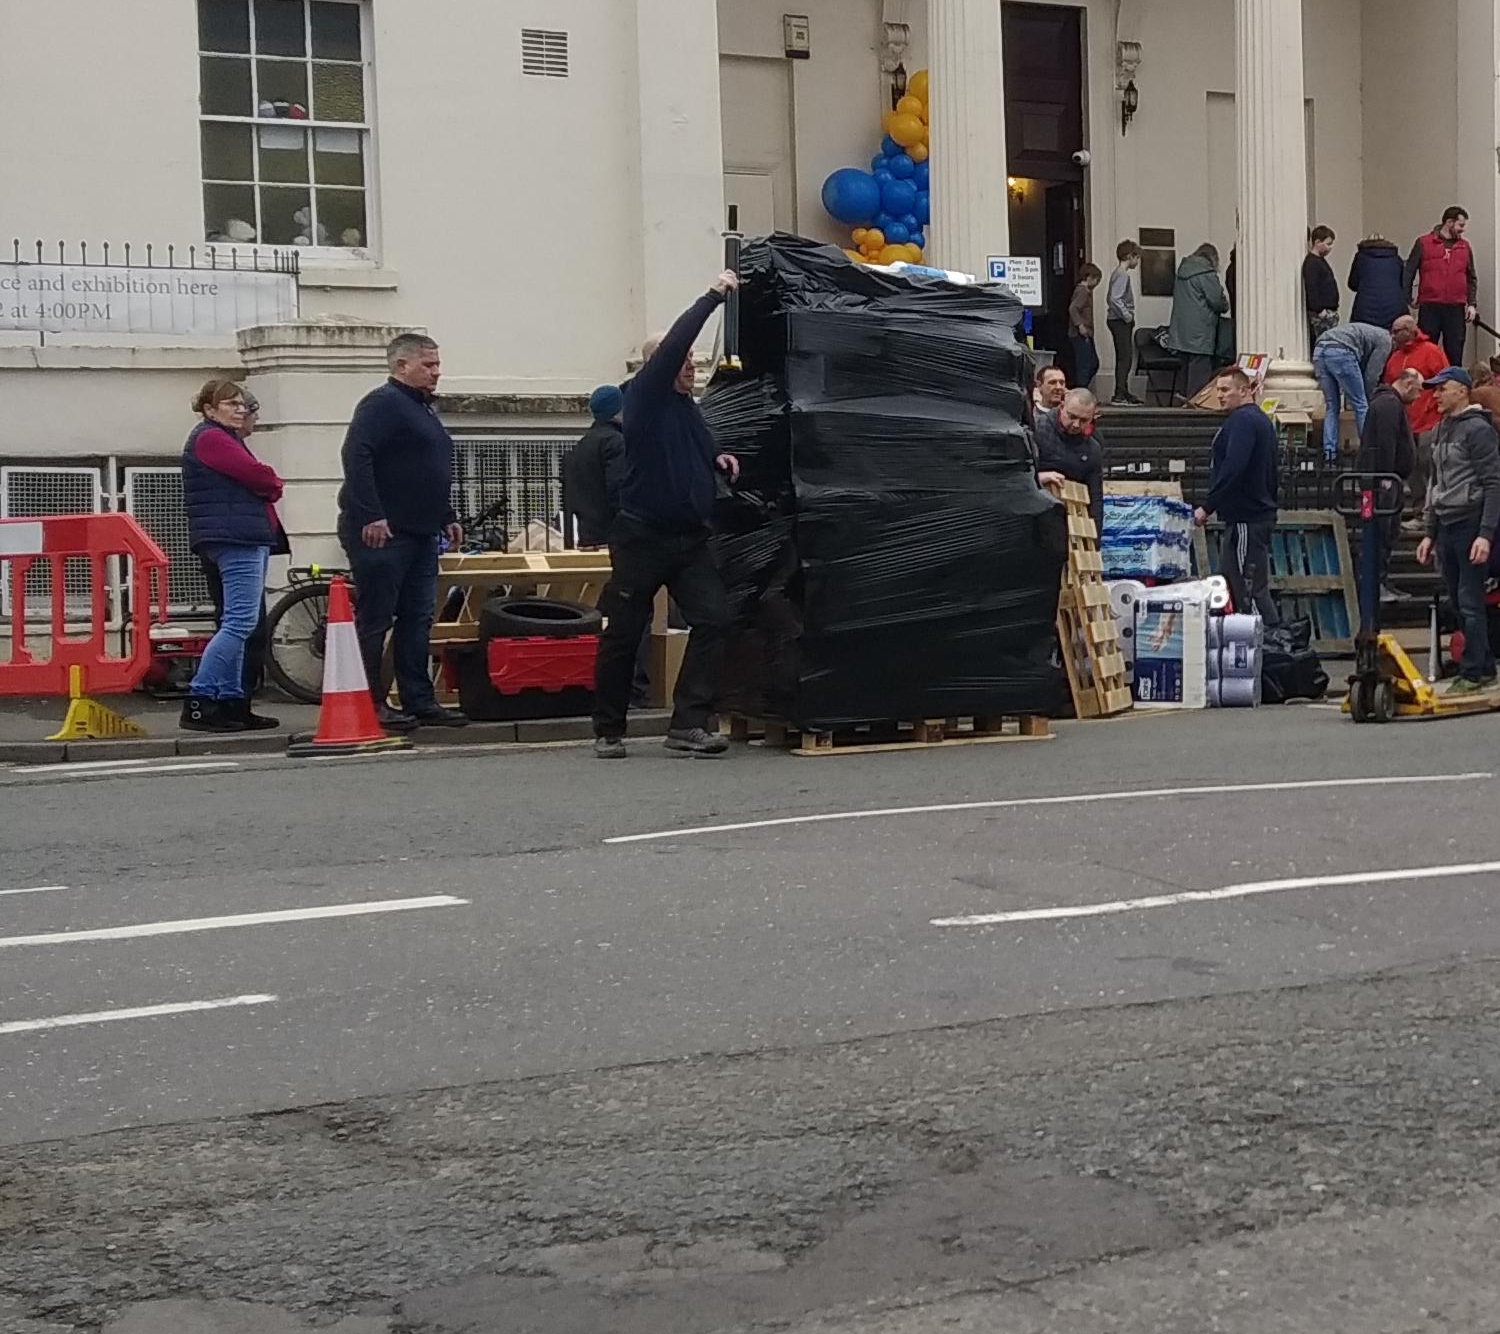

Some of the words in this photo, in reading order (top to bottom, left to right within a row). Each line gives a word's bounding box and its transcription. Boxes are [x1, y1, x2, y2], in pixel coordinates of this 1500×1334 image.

[27, 273, 65, 292] and
[71, 273, 171, 295] exhibition
[177, 277, 219, 296] here
[11, 304, 28, 319] at
[35, 302, 112, 320] 4:00PM
